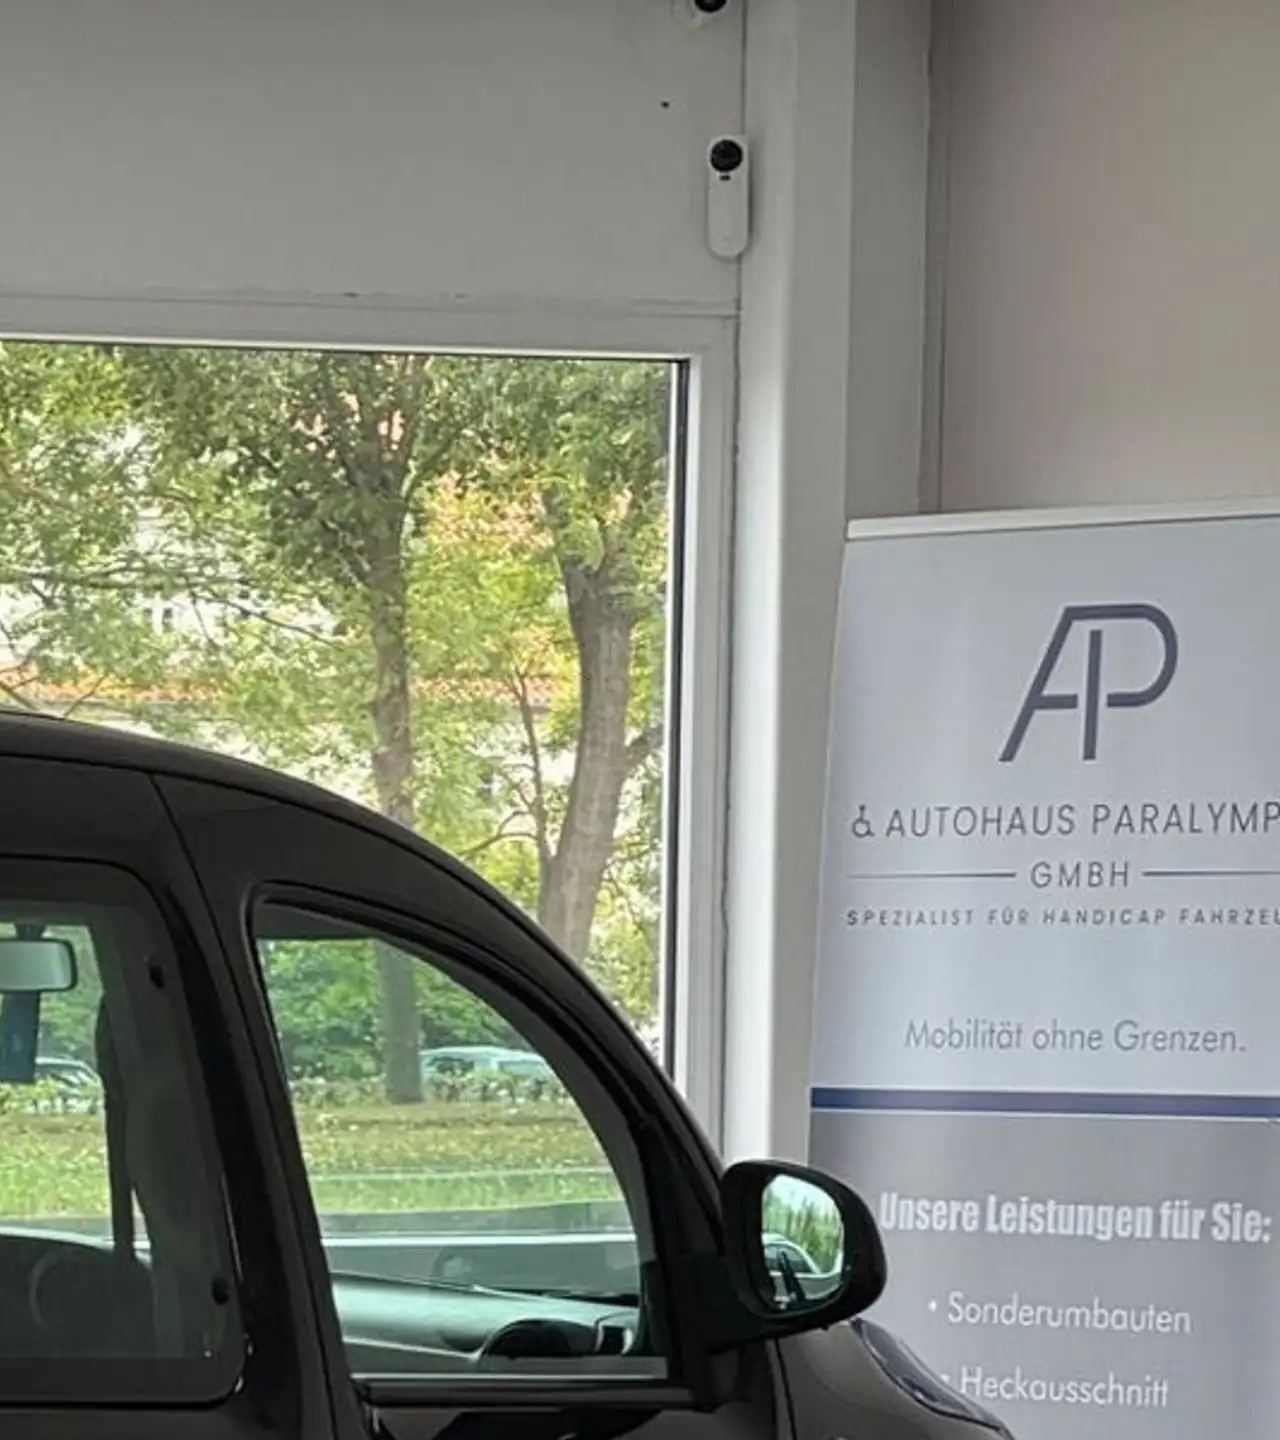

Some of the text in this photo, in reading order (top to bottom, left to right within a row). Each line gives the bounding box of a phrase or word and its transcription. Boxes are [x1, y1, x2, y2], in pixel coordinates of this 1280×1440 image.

[886, 801, 1280, 838] AUTOHAUS PARALYMP
[1029, 860, 1130, 889] GMBH
[846, 909, 975, 927] SPEZIALIST
[987, 905, 1030, 926] FÜR
[1042, 907, 1168, 926] HANDICAP
[904, 1015, 1248, 1053] Mobilität ohne Grenzen.
[879, 1190, 1272, 1244] Unsere Leistungen für Sie:
[947, 1290, 1192, 1336] Sonderumbauten
[959, 1364, 1170, 1408] Heckausschnitt
